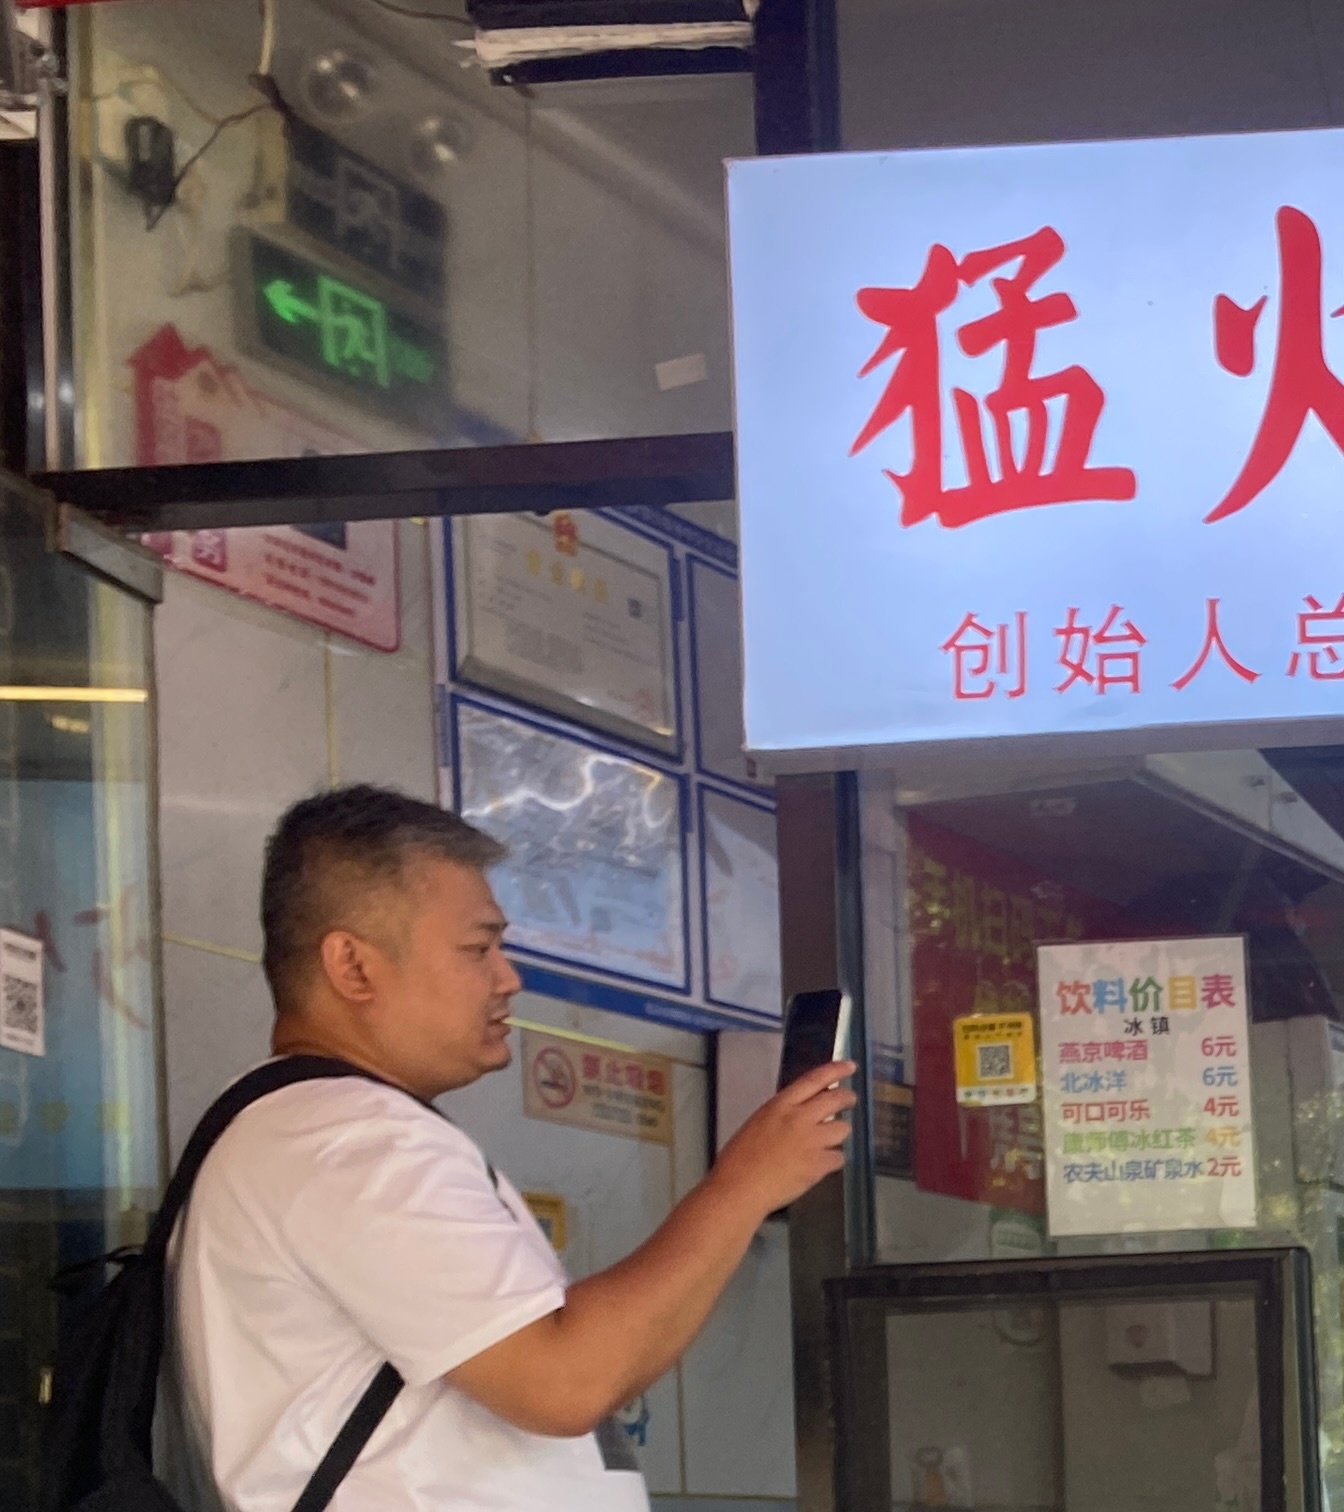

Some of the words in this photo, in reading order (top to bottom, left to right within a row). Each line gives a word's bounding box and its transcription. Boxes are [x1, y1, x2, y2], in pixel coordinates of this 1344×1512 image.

[1056, 973, 1236, 1015] 饮料价目表
[1124, 1016, 1170, 1036] 冰镇
[1058, 1040, 1149, 1064] 燕京啤酒
[1202, 1036, 1237, 1057] 6元
[1061, 1070, 1127, 1093] 北冰洋
[1203, 1066, 1238, 1087] 6元
[1061, 1099, 1151, 1123] 可口可乐
[1203, 1096, 1240, 1117] 4元
[1205, 1125, 1242, 1147] 4元
[1063, 1158, 1203, 1184] 农夫山泉矿泉水
[1206, 1156, 1242, 1178] 2元
